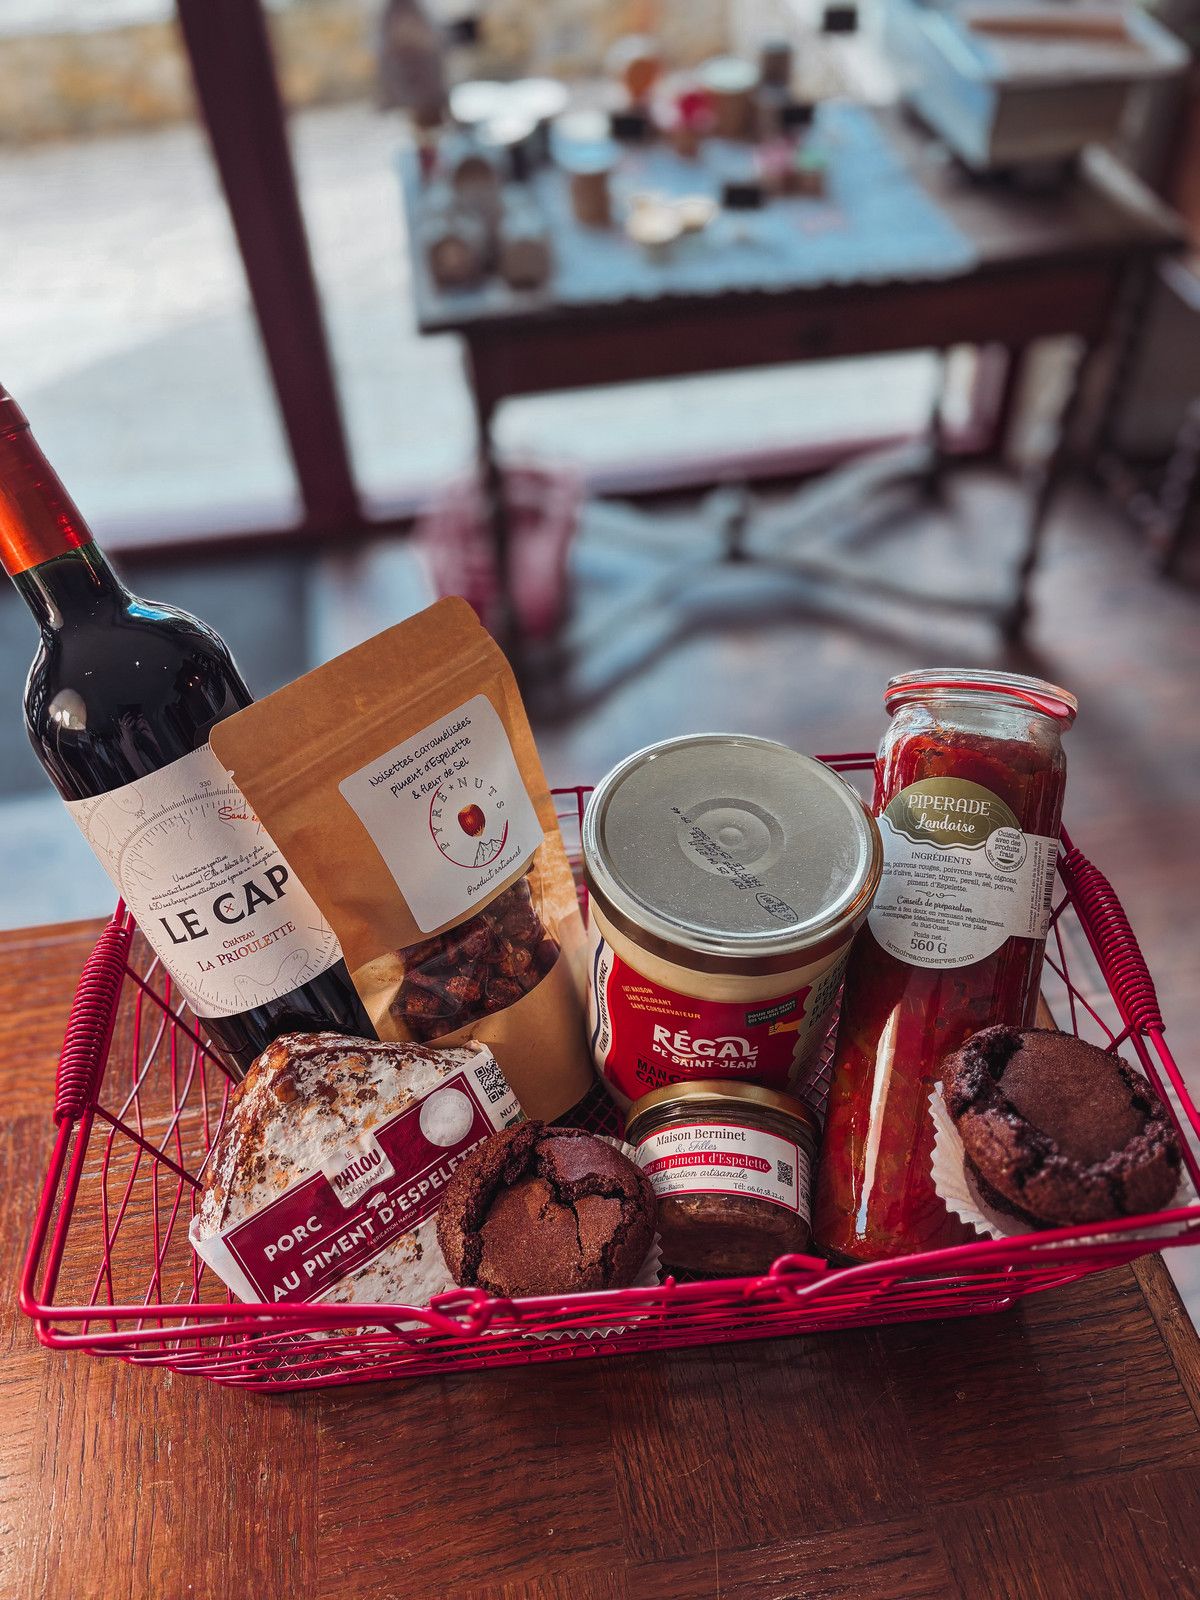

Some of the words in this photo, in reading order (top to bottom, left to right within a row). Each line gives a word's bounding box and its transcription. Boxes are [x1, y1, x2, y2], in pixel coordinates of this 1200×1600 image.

[368, 755, 414, 787] Noisettes
[414, 716, 471, 759] caramélisées
[390, 767, 423, 798] piment
[424, 737, 471, 772] d'Espelette
[198, 779, 211, 788] 330
[411, 790, 421, 799] &
[420, 775, 442, 794] fleur
[443, 768, 454, 778] de
[452, 756, 469, 770] Sel
[217, 806, 249, 821] Sans
[908, 794, 991, 816] PIPERADE
[915, 813, 976, 833] Landaise
[995, 843, 1019, 853] produits
[998, 850, 1014, 859] frais
[911, 851, 972, 865] INGRÉDIENTS
[466, 868, 493, 896] Produit
[488, 845, 521, 874] artisanal
[892, 862, 916, 870] poivrons
[918, 864, 942, 873] rouges,
[943, 866, 972, 876] poivrons
[974, 871, 992, 880] verts,
[907, 879, 930, 888] piment
[914, 871, 937, 880] laurier,
[960, 877, 980, 888] persil,
[981, 879, 993, 889] sel,
[158, 908, 209, 944] LE
[212, 864, 288, 924] CAP
[896, 895, 922, 906] Conseils
[925, 899, 932, 907] de
[913, 907, 926, 915] doux
[937, 911, 963, 921] remuant
[948, 918, 961, 926] tous
[973, 923, 987, 931] plats
[913, 930, 930, 938] Poids
[885, 940, 974, 965] larmoireaconserves.com
[910, 939, 934, 952] 560
[937, 943, 947, 954] G
[645, 1004, 701, 1019] CONSERVATEUR
[653, 1024, 759, 1061] RÉGAL
[652, 1044, 668, 1059] DE
[671, 1057, 756, 1069] SAINT-JEAN
[636, 1058, 687, 1084] MANC
[636, 1070, 664, 1088] CAN
[499, 1099, 518, 1118] NUTR
[656, 1131, 691, 1147] Maison
[695, 1128, 746, 1142] Berninet
[688, 1140, 717, 1152] Filles
[344, 1150, 354, 1160] LE
[656, 1160, 668, 1169] au
[668, 1154, 705, 1169] piment
[708, 1153, 769, 1171] d'Espelette
[332, 1148, 381, 1191] PHILOU
[651, 1169, 697, 1184] Fabrication
[700, 1168, 748, 1180] artisanale
[343, 1166, 385, 1197] NORMAND
[733, 1182, 746, 1190] Tél:
[263, 1215, 322, 1262] PORC
[273, 1270, 300, 1302] AU
[302, 1217, 374, 1277] PIMENT
